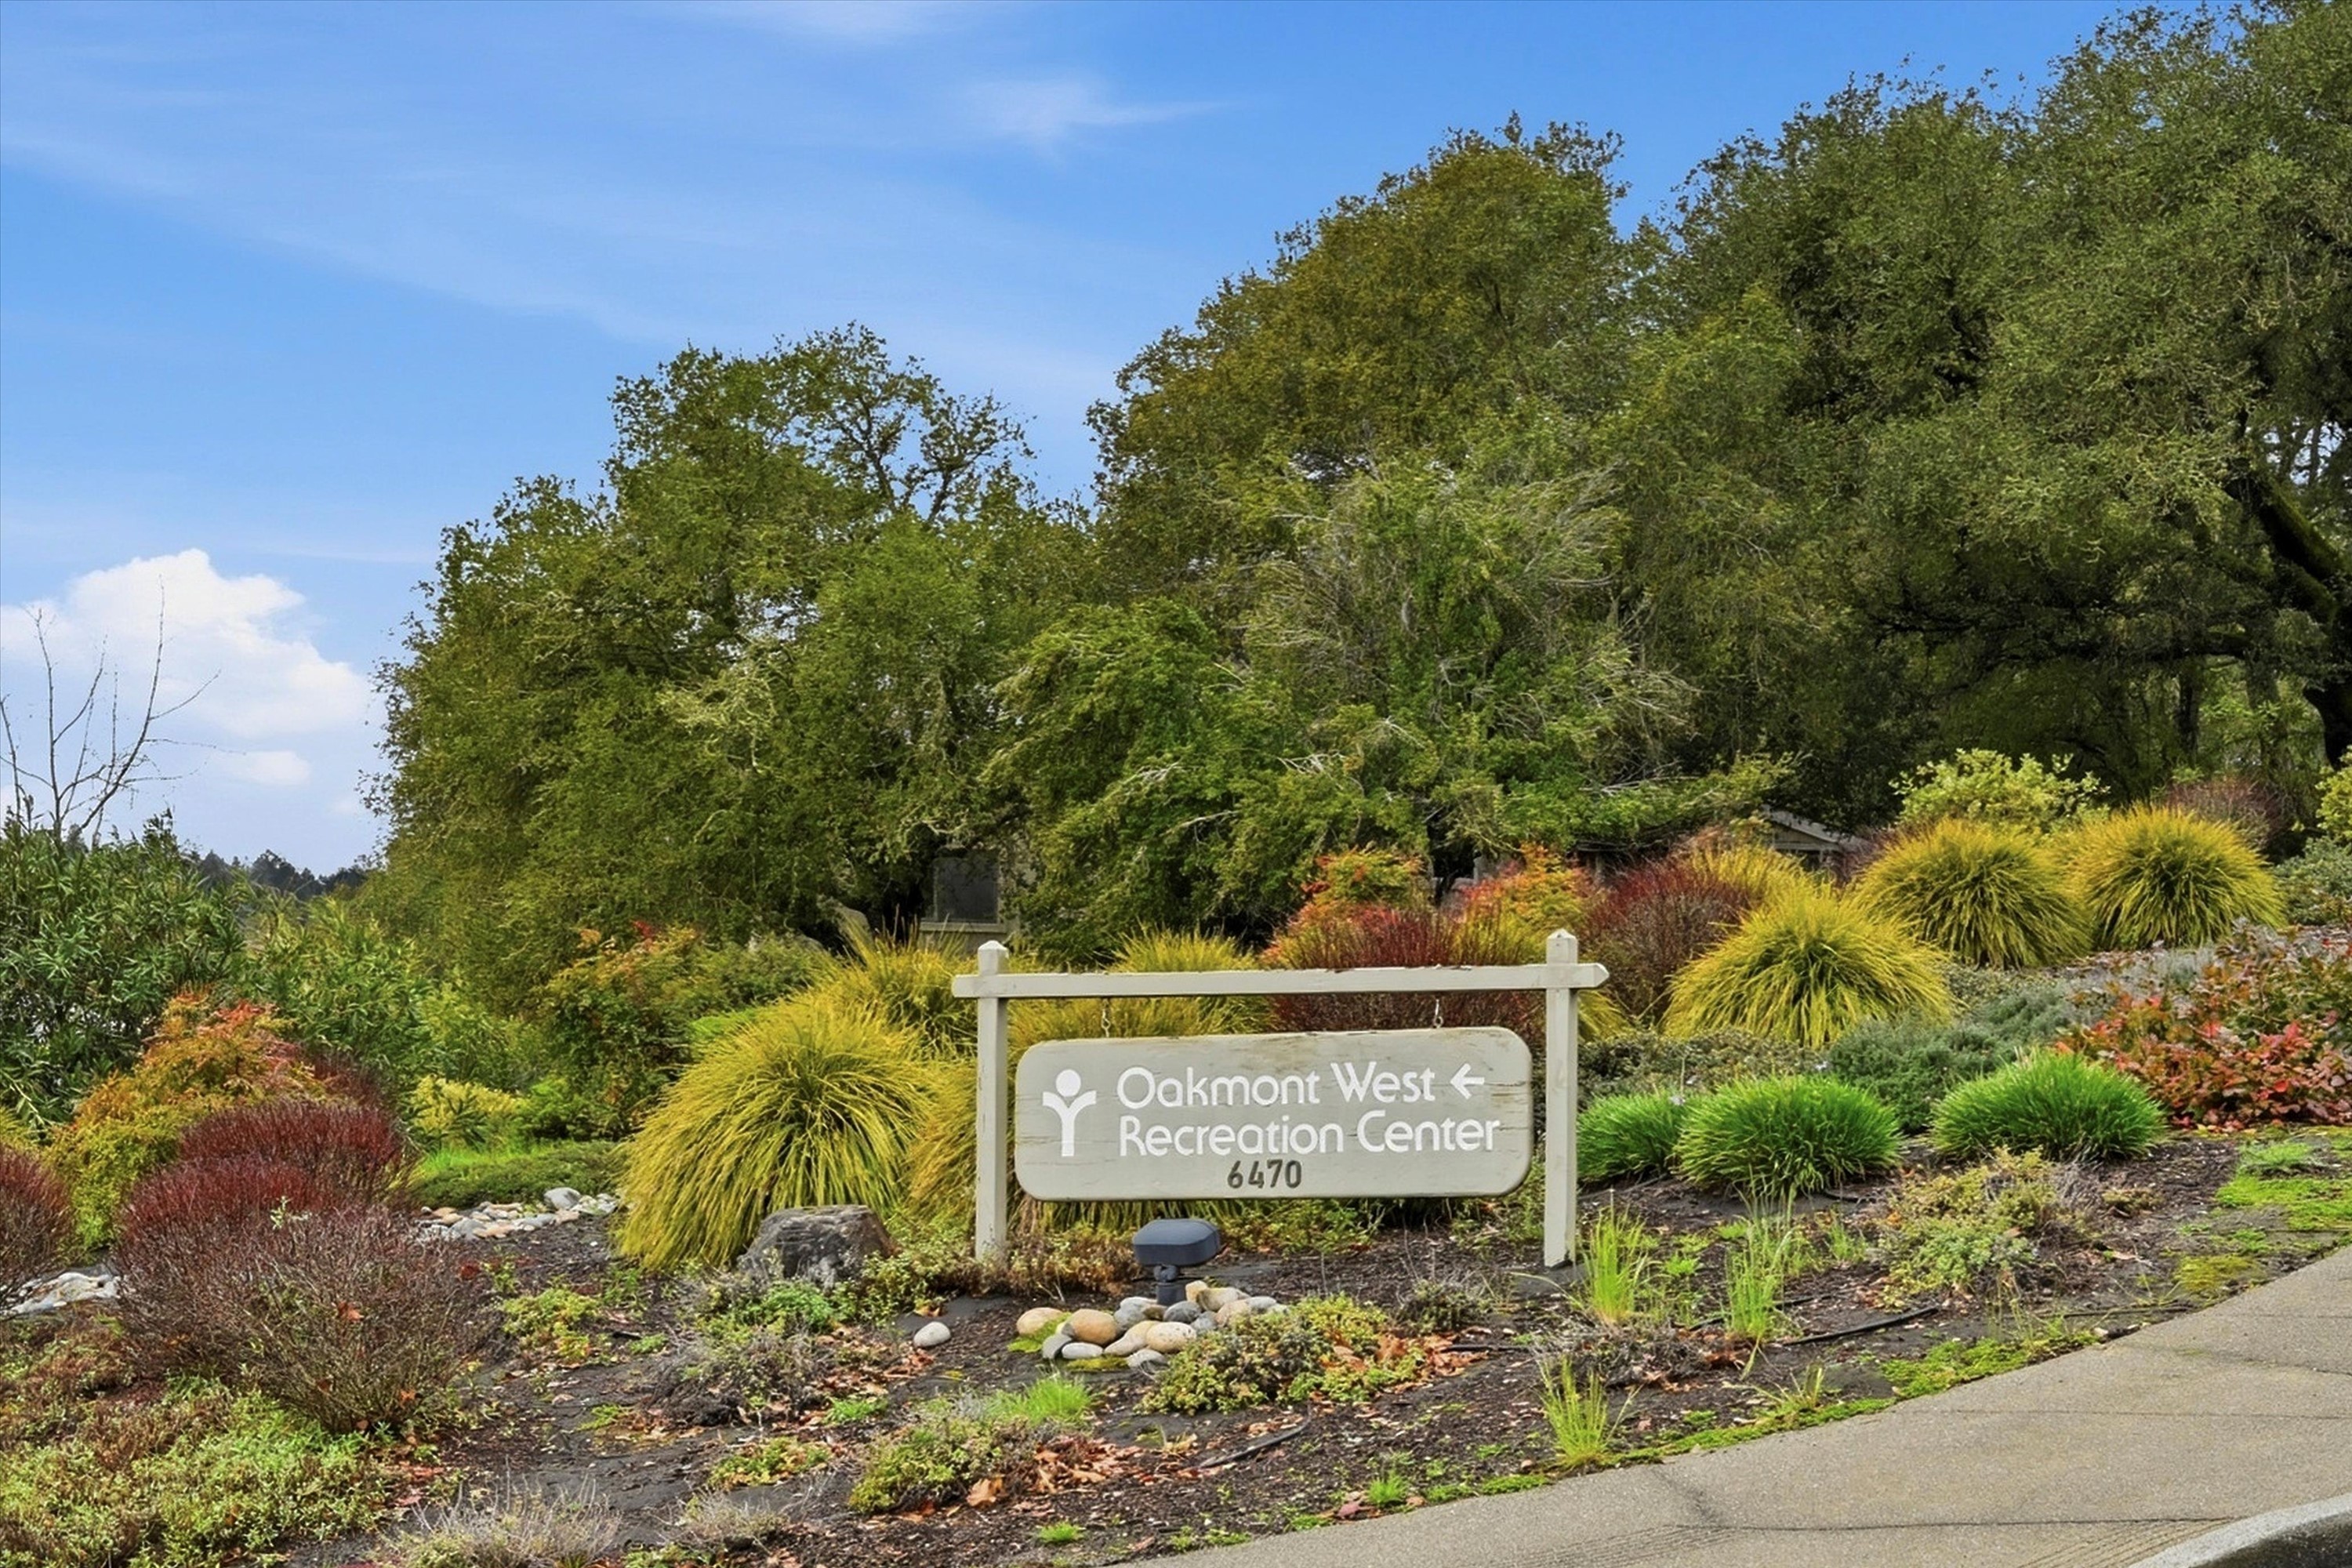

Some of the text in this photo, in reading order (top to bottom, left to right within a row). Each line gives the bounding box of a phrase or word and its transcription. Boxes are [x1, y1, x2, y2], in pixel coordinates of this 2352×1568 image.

[1116, 1061, 1436, 1109] Oakmont West
[1119, 1109, 1501, 1157] Recreation Center
[1226, 1159, 1303, 1189] 6470
